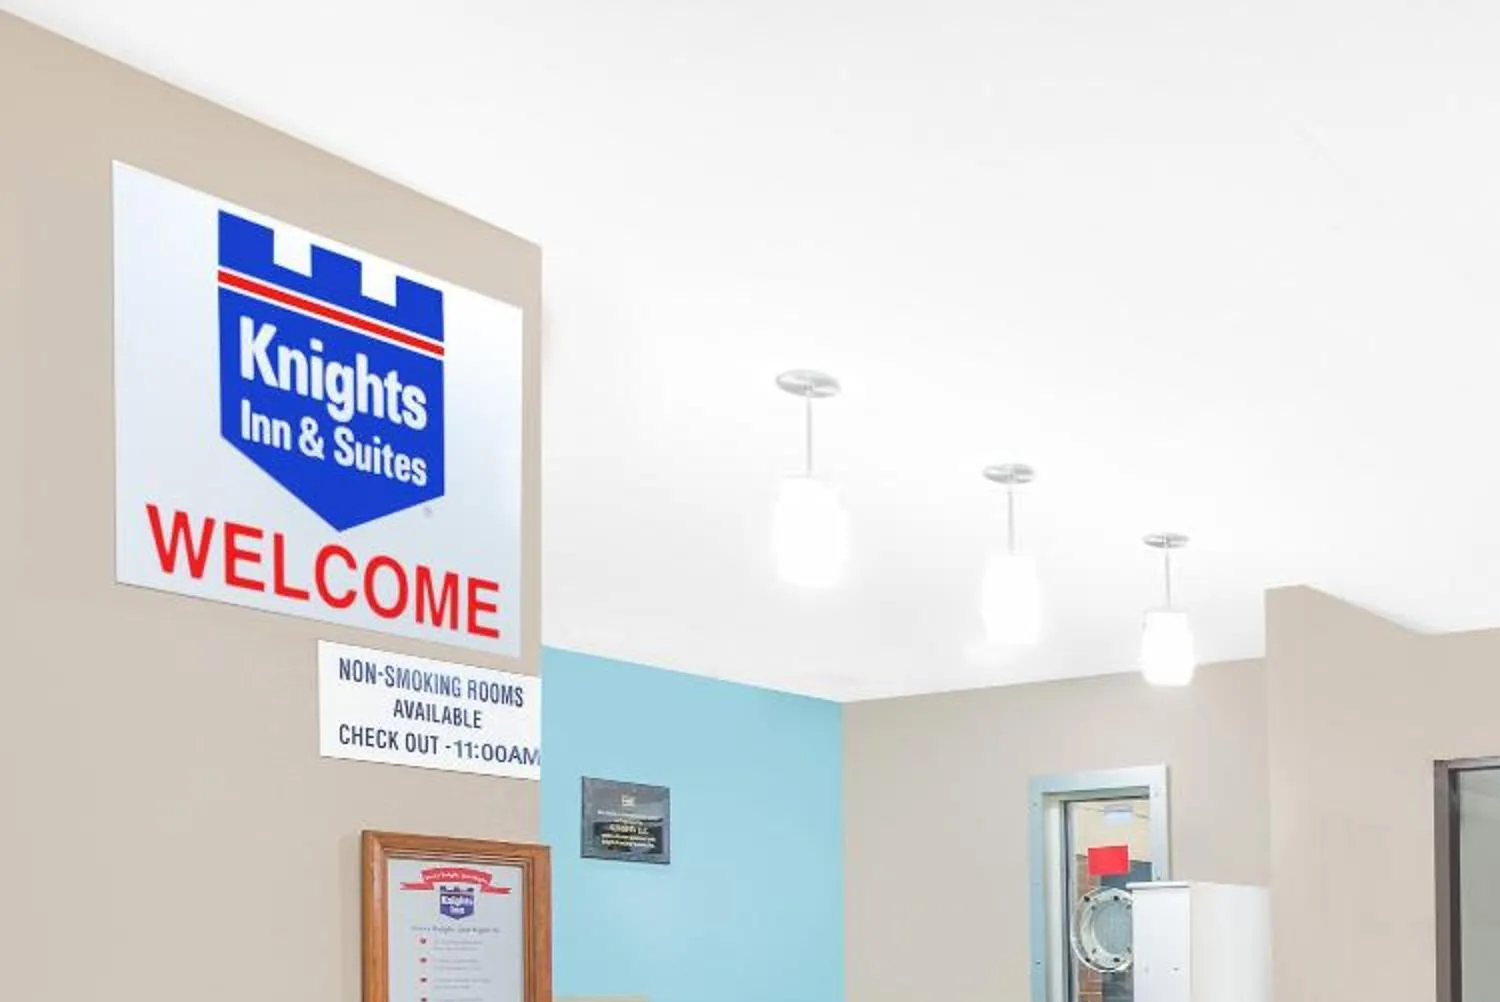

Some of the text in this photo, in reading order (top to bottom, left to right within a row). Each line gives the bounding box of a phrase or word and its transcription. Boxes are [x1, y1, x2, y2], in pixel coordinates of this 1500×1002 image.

[240, 315, 427, 430] Knights
[241, 400, 427, 487] Inn & Suites
[146, 503, 500, 638] WELCOME
[338, 657, 524, 707] NON-SMOKING ROOMS
[393, 699, 482, 729] AVAILABLE
[339, 724, 399, 750] CHECK
[405, 733, 439, 755] OUT
